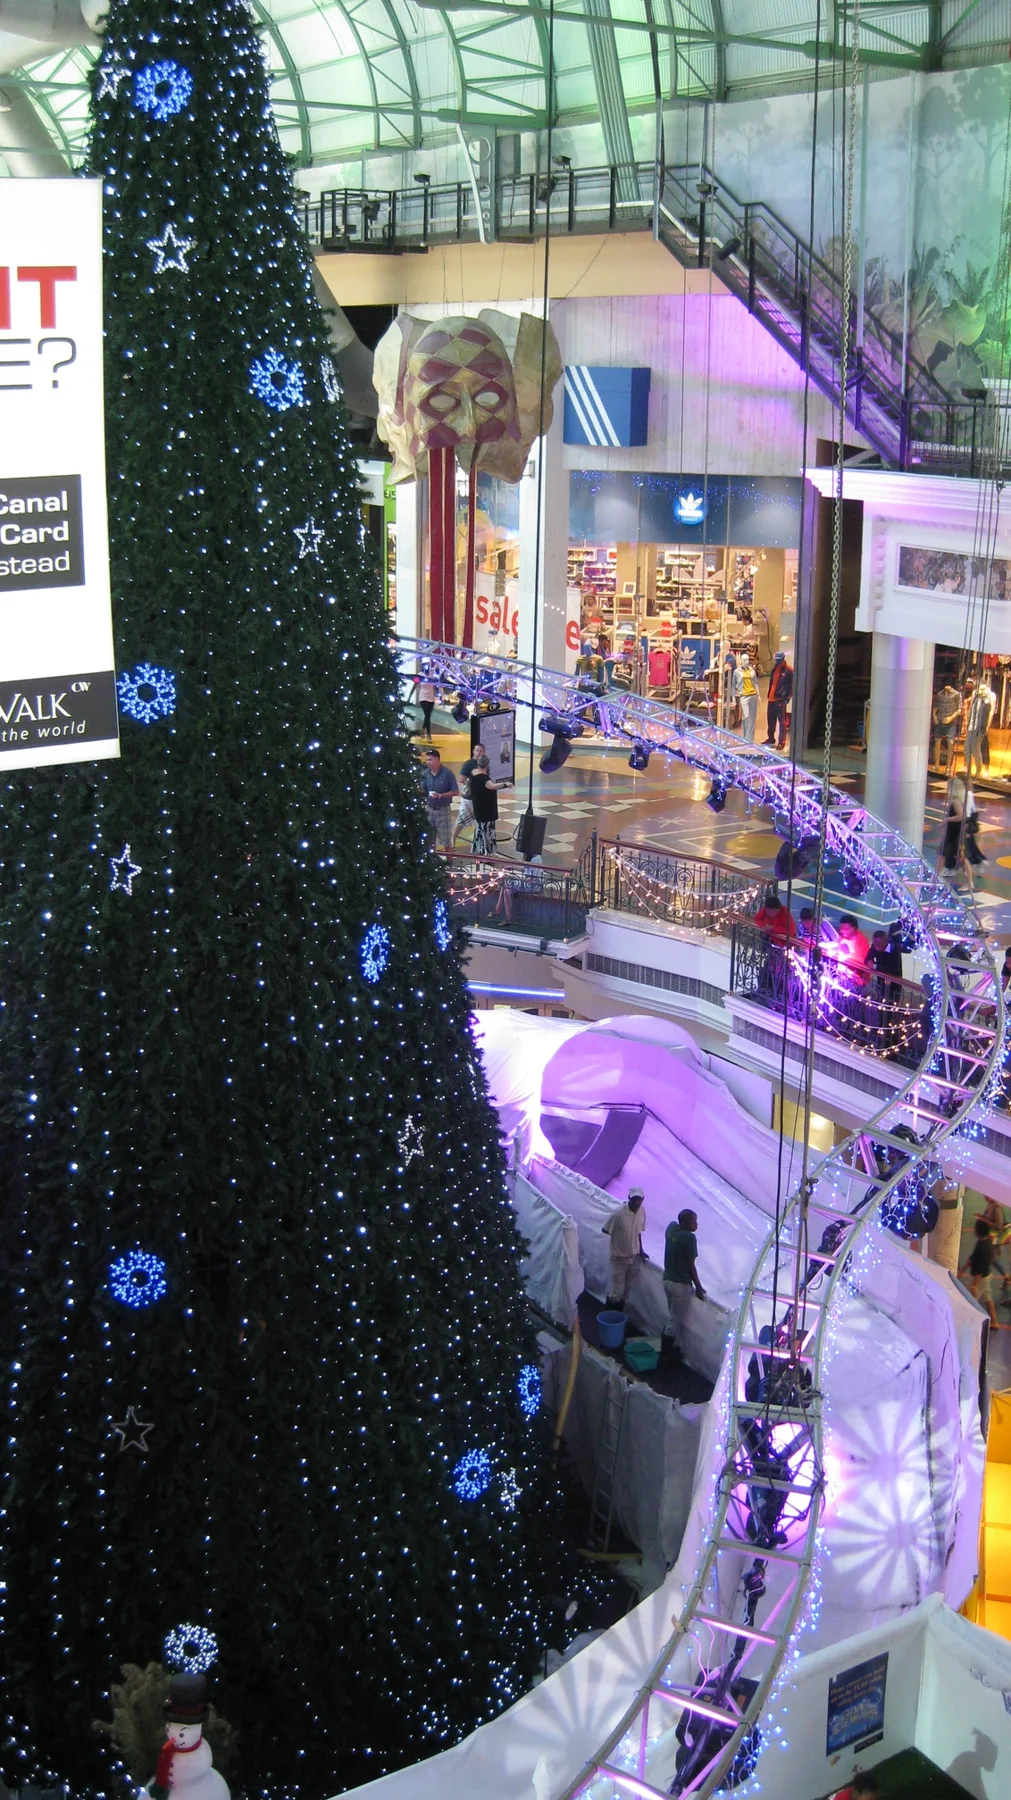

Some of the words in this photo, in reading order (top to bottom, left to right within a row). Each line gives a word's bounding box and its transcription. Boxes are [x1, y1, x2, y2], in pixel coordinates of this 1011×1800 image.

[0, 520, 69, 546] Card
[2, 728, 29, 743] the
[38, 719, 86, 739] world
